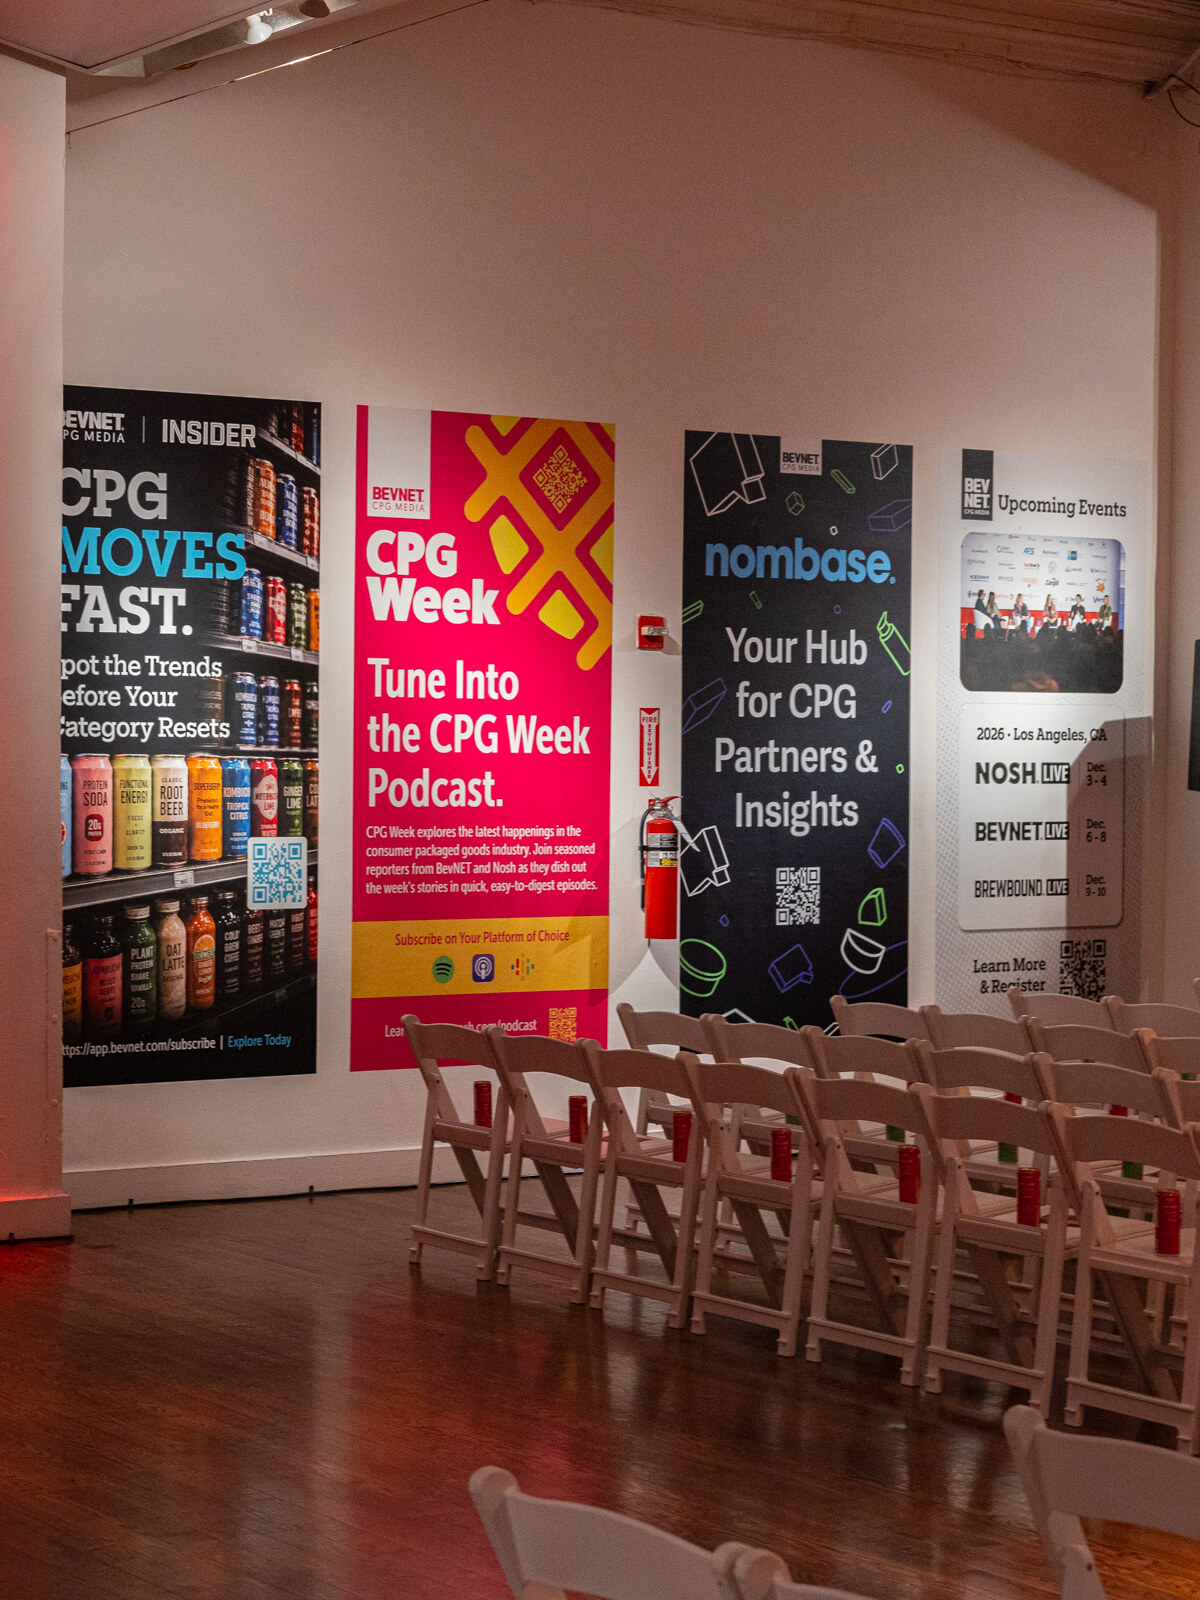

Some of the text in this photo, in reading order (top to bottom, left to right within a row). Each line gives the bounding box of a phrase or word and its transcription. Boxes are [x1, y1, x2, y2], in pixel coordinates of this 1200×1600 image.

[63, 429, 125, 443] PG MEDIA
[162, 418, 256, 448] INSIDER
[62, 467, 168, 520] CPG
[372, 501, 425, 512] CPG MEDIA
[998, 494, 1127, 518] Upcoming Events
[62, 525, 247, 580] MOVES
[365, 529, 458, 578] CPG
[365, 576, 501, 625] Week
[725, 627, 868, 666] Your Hub
[61, 654, 222, 680] pot the Trends
[367, 657, 519, 700] Tune Into
[62, 684, 179, 707] efore Your
[736, 680, 857, 719] for CPG
[61, 714, 231, 743] ategory Resets
[367, 712, 591, 755] the CPG Week
[976, 727, 1108, 744] 2026 Los Angeles, CA
[714, 737, 879, 773] Partners &
[1043, 763, 1069, 782] LIVE
[1087, 761, 1108, 773] Dec.
[83, 780, 108, 790] PROTEIN
[160, 785, 184, 800] ROOT
[368, 767, 504, 808] Podcast.
[83, 792, 108, 807] SODA
[120, 790, 149, 804] ENERGY
[160, 801, 184, 816] BEER
[735, 790, 860, 837] Insights
[366, 825, 581, 840] CPG Week explores the latest happenings in the
[1046, 823, 1069, 839] LIVE
[1085, 819, 1107, 829] Dec.
[366, 843, 595, 859] consumer packaged goods industry. Join seasoned
[366, 862, 586, 878] reporters from BevNET and Nosh as they dish out
[366, 880, 597, 895] the week's stories in quick, easy-to-digest episodes.
[1047, 880, 1068, 895] LIVE
[1085, 874, 1106, 885] Dec.
[395, 930, 569, 946] Subscribe on Your Platform of Choice
[131, 945, 154, 960] PLANT
[166, 943, 182, 957] OAT
[162, 956, 185, 971] LATTE
[973, 957, 1046, 973] Learn More
[980, 980, 990, 994] &
[62, 1033, 292, 1059] ttps://app.bevnet.com/subscribe Explore Today
